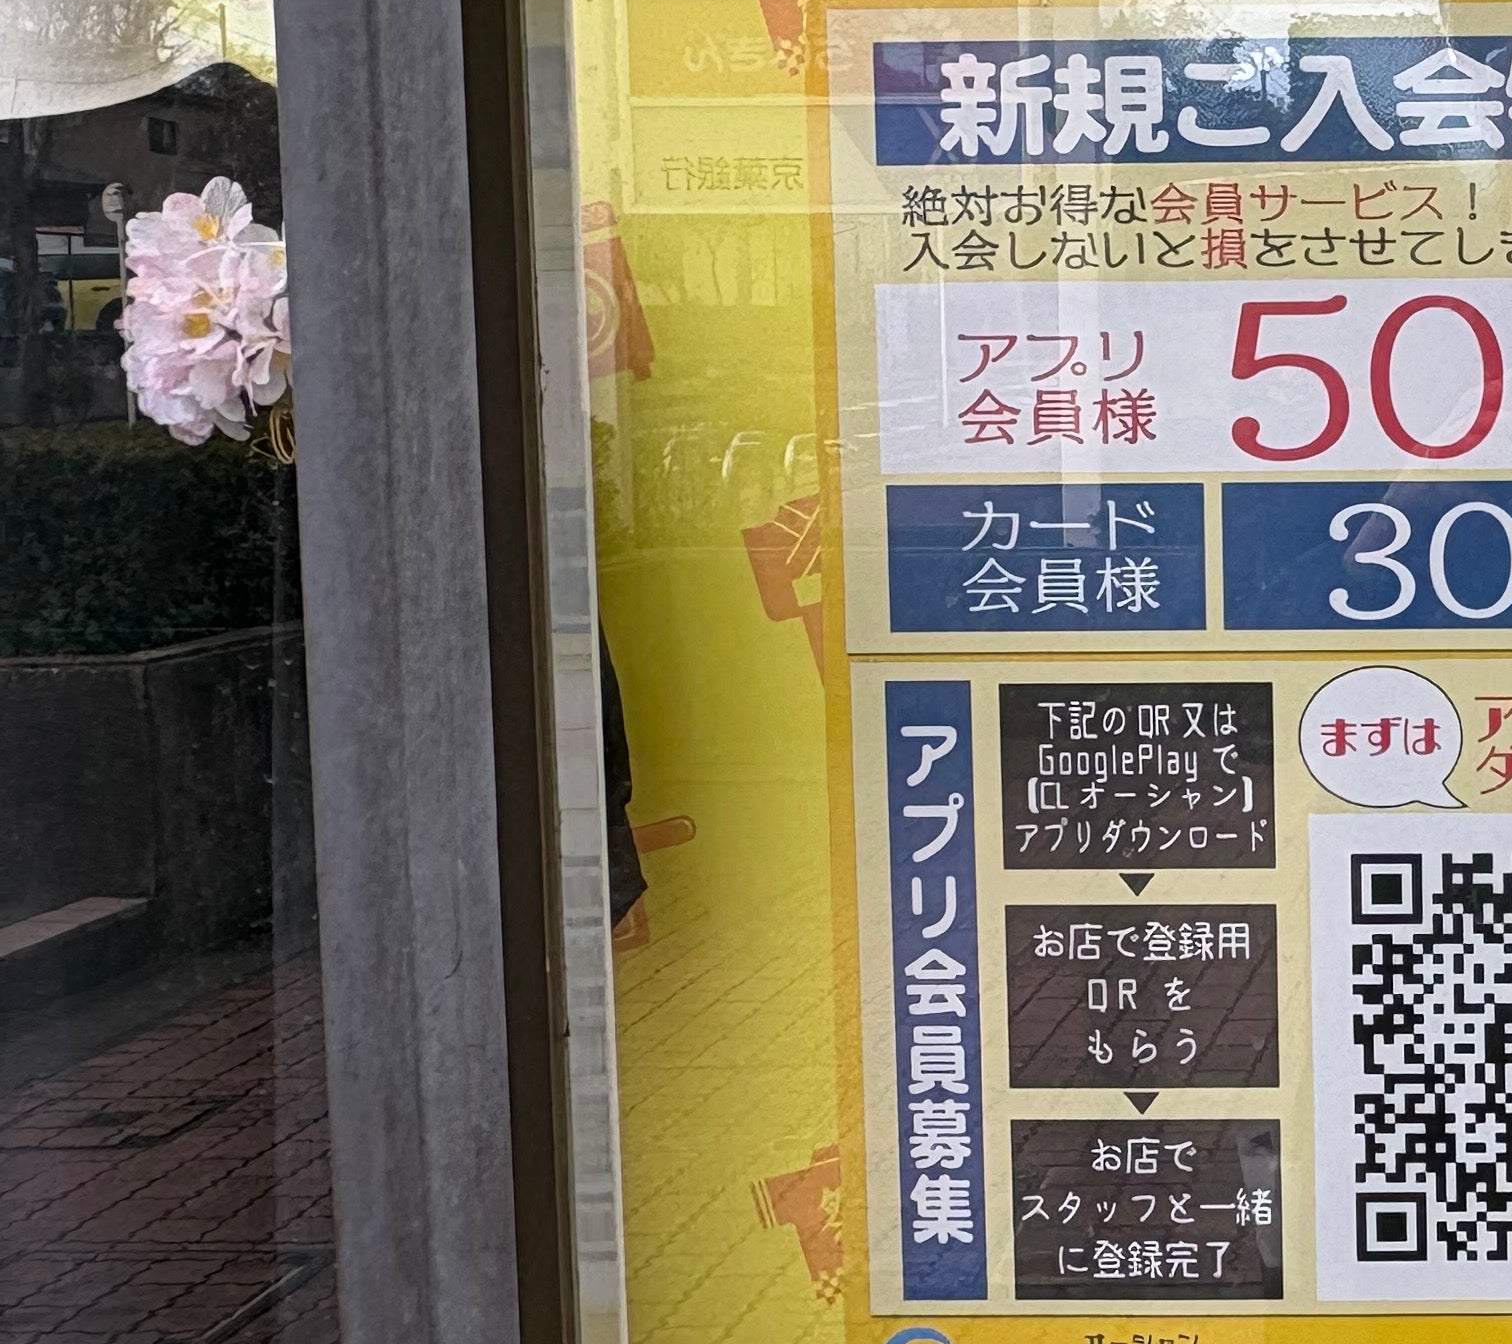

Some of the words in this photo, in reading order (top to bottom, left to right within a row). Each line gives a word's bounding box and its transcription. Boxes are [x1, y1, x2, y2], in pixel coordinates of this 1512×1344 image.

[901, 181, 1477, 227] 絶対お得な会員サービス！
[957, 330, 1146, 383] アプリ
[1230, 293, 1504, 462] 50
[957, 389, 1158, 447] 会員様
[961, 498, 1156, 554] カード
[962, 557, 1161, 616] 会員様
[1319, 716, 1442, 757] まずは
[1015, 816, 1268, 855] アプリダウンロード
[1032, 921, 1251, 962] お店で登録用
[900, 724, 974, 1245] アプリ会員募集
[1086, 1029, 1199, 1066] もらう
[1090, 1138, 1197, 1174] お店で
[1020, 1188, 1273, 1227] スタッフと一緒
[1058, 1240, 1231, 1280] に登録完了
